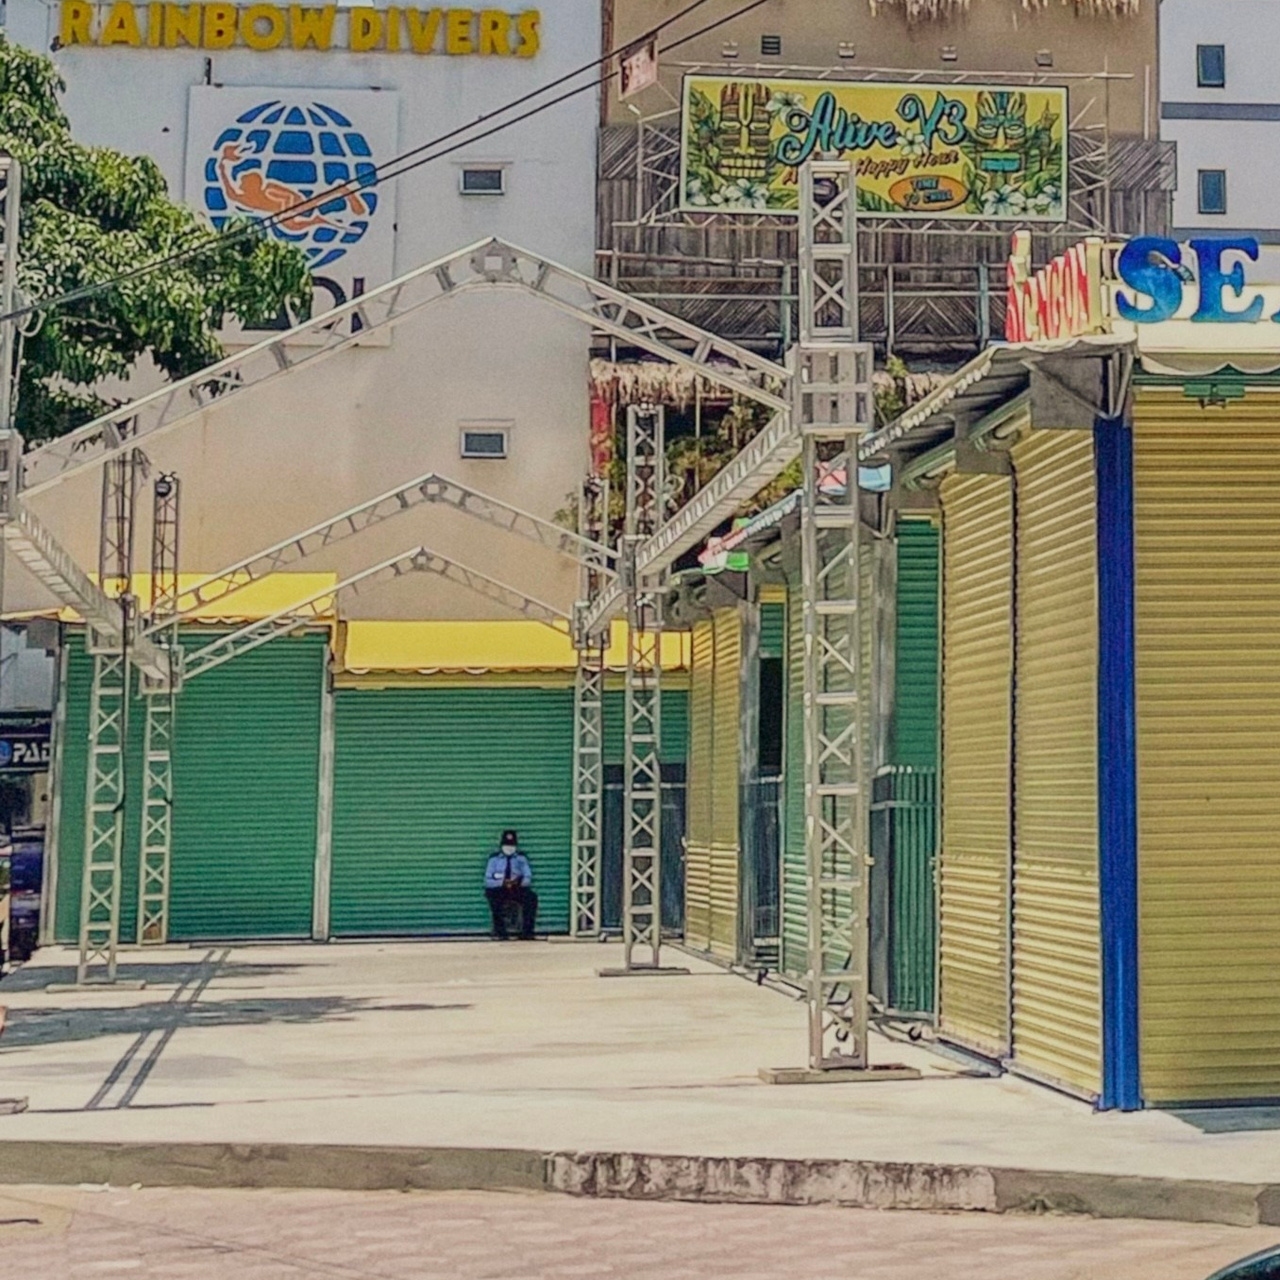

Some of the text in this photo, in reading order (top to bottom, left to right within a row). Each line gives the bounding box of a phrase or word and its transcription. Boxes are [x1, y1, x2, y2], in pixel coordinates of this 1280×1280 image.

[350, 5, 542, 60] DIVERS
[776, 90, 968, 166] Alive V3
[855, 157, 910, 180] Happy
